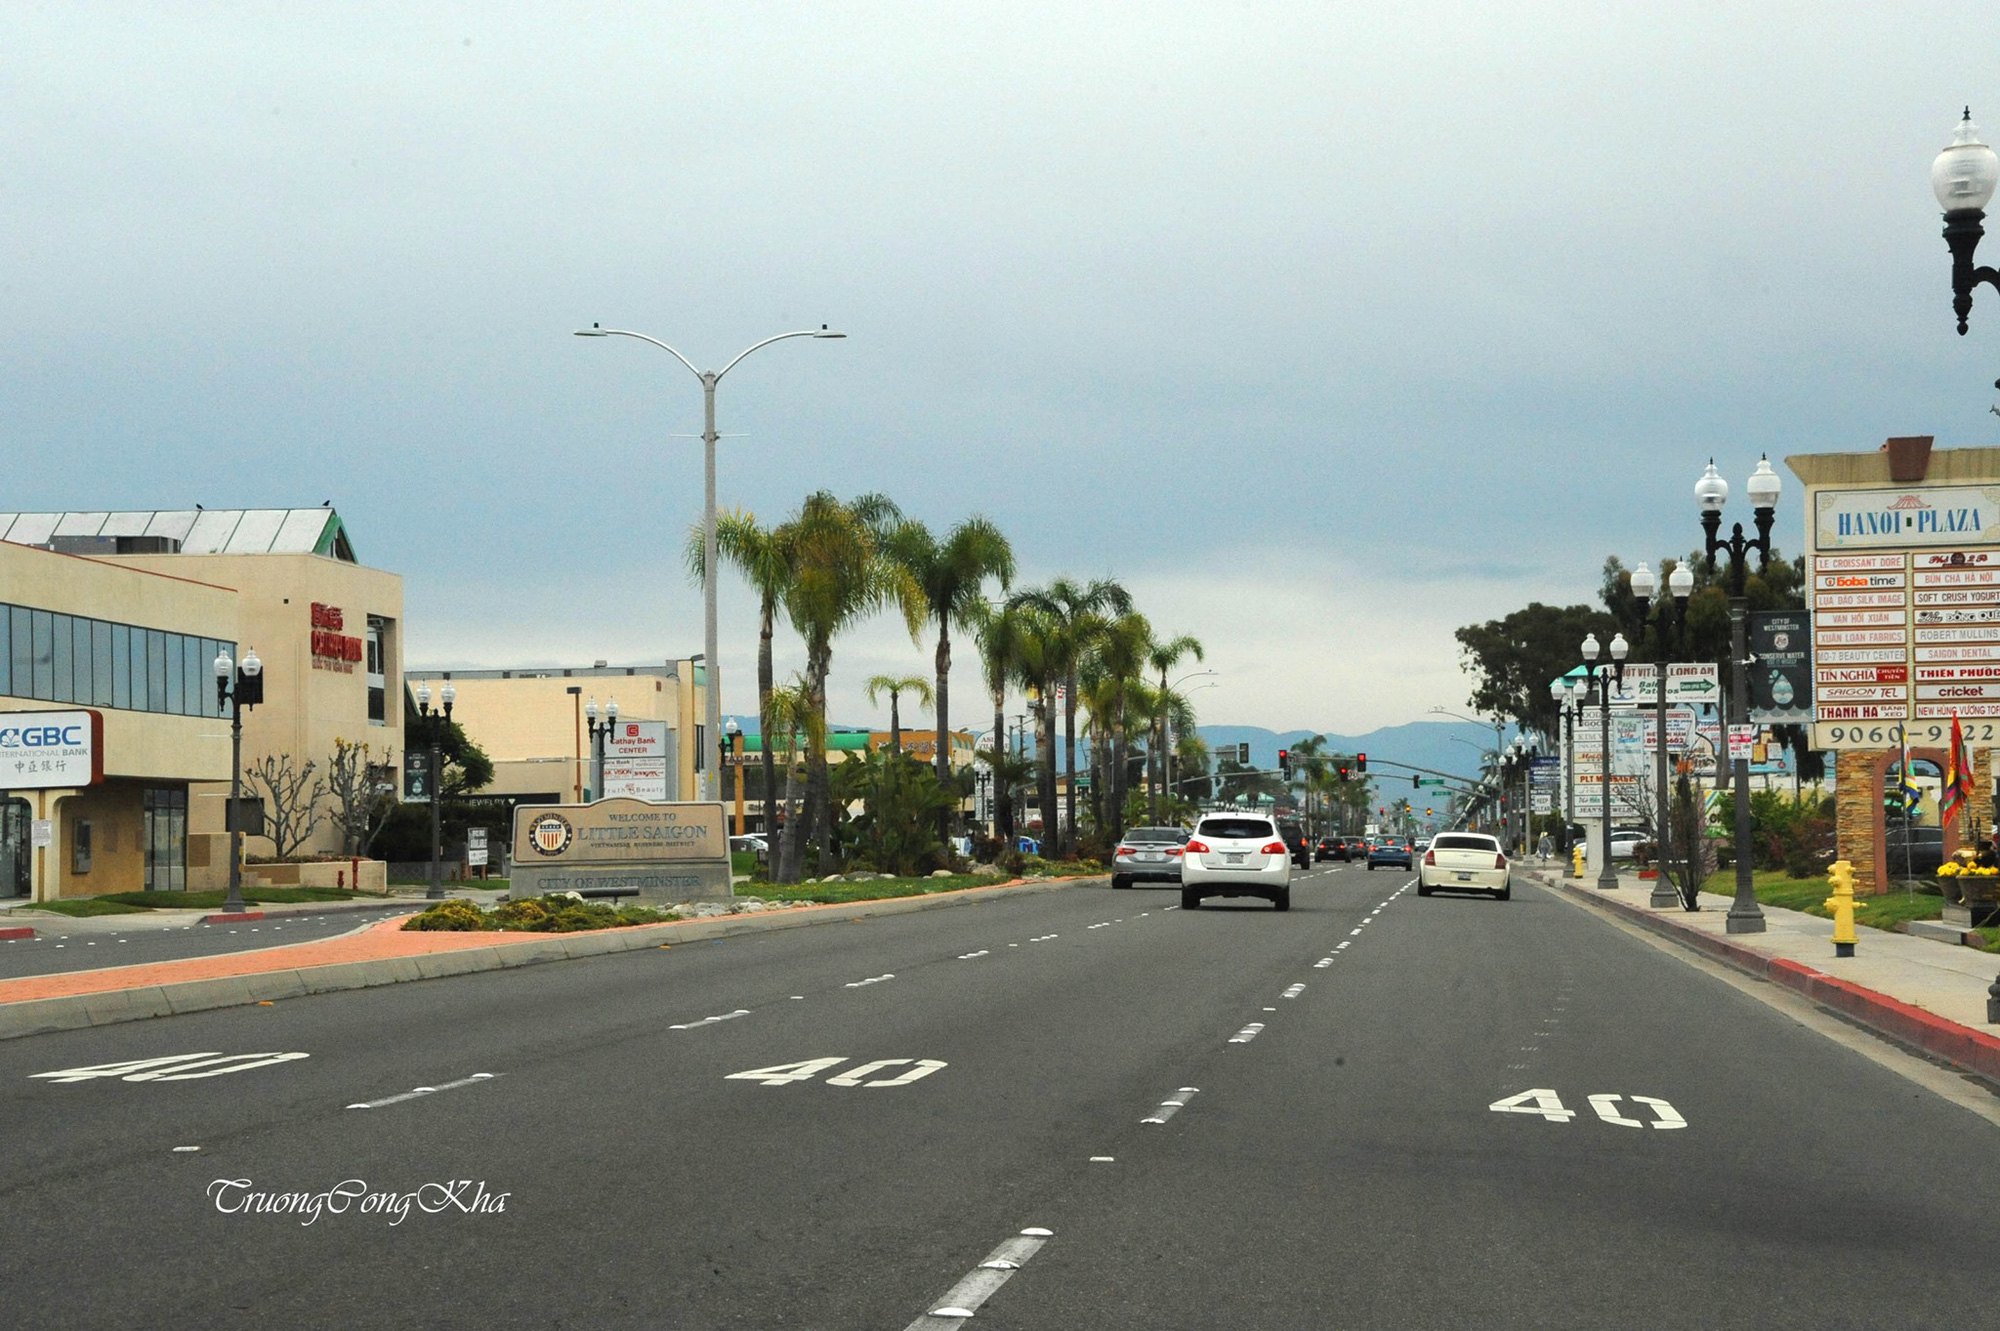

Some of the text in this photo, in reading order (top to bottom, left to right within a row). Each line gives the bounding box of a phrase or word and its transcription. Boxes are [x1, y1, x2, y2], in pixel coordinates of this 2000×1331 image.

[1838, 508, 1981, 536] HANOI PLAZA
[1819, 560, 1829, 568] LE
[1832, 559, 1876, 567] CROISSANT
[1836, 576, 1896, 587] boba time
[1856, 595, 1874, 604] SILK
[1877, 594, 1903, 604] IMAGE
[1918, 591, 2000, 602] SOFT CRUSH YOGURT
[1845, 633, 1866, 642] LOAN
[1869, 632, 1902, 641] FABRICS
[1920, 628, 1999, 640] ROBERT MULLINS
[1838, 651, 1870, 660] BEAUTY
[1873, 650, 1905, 660] CENTER
[1928, 648, 1993, 658] SAIGON DENTAL
[1670, 667, 1697, 676] LONG
[1700, 667, 1714, 676] AN
[1827, 687, 1898, 698] SAIGON TEL
[1938, 686, 1984, 697] cricket
[1819, 707, 1859, 718] THANH
[1918, 707, 1935, 716] NEW
[22, 726, 81, 746] GBC
[62, 748, 88, 756] BANK
[609, 812, 677, 822] WELCOME TO
[577, 825, 708, 841] LITTLE SAIGON
[537, 875, 701, 889] CITY OF WESTMINSTER
[723, 1056, 949, 1087] 40
[1488, 1088, 1688, 1130] 40
